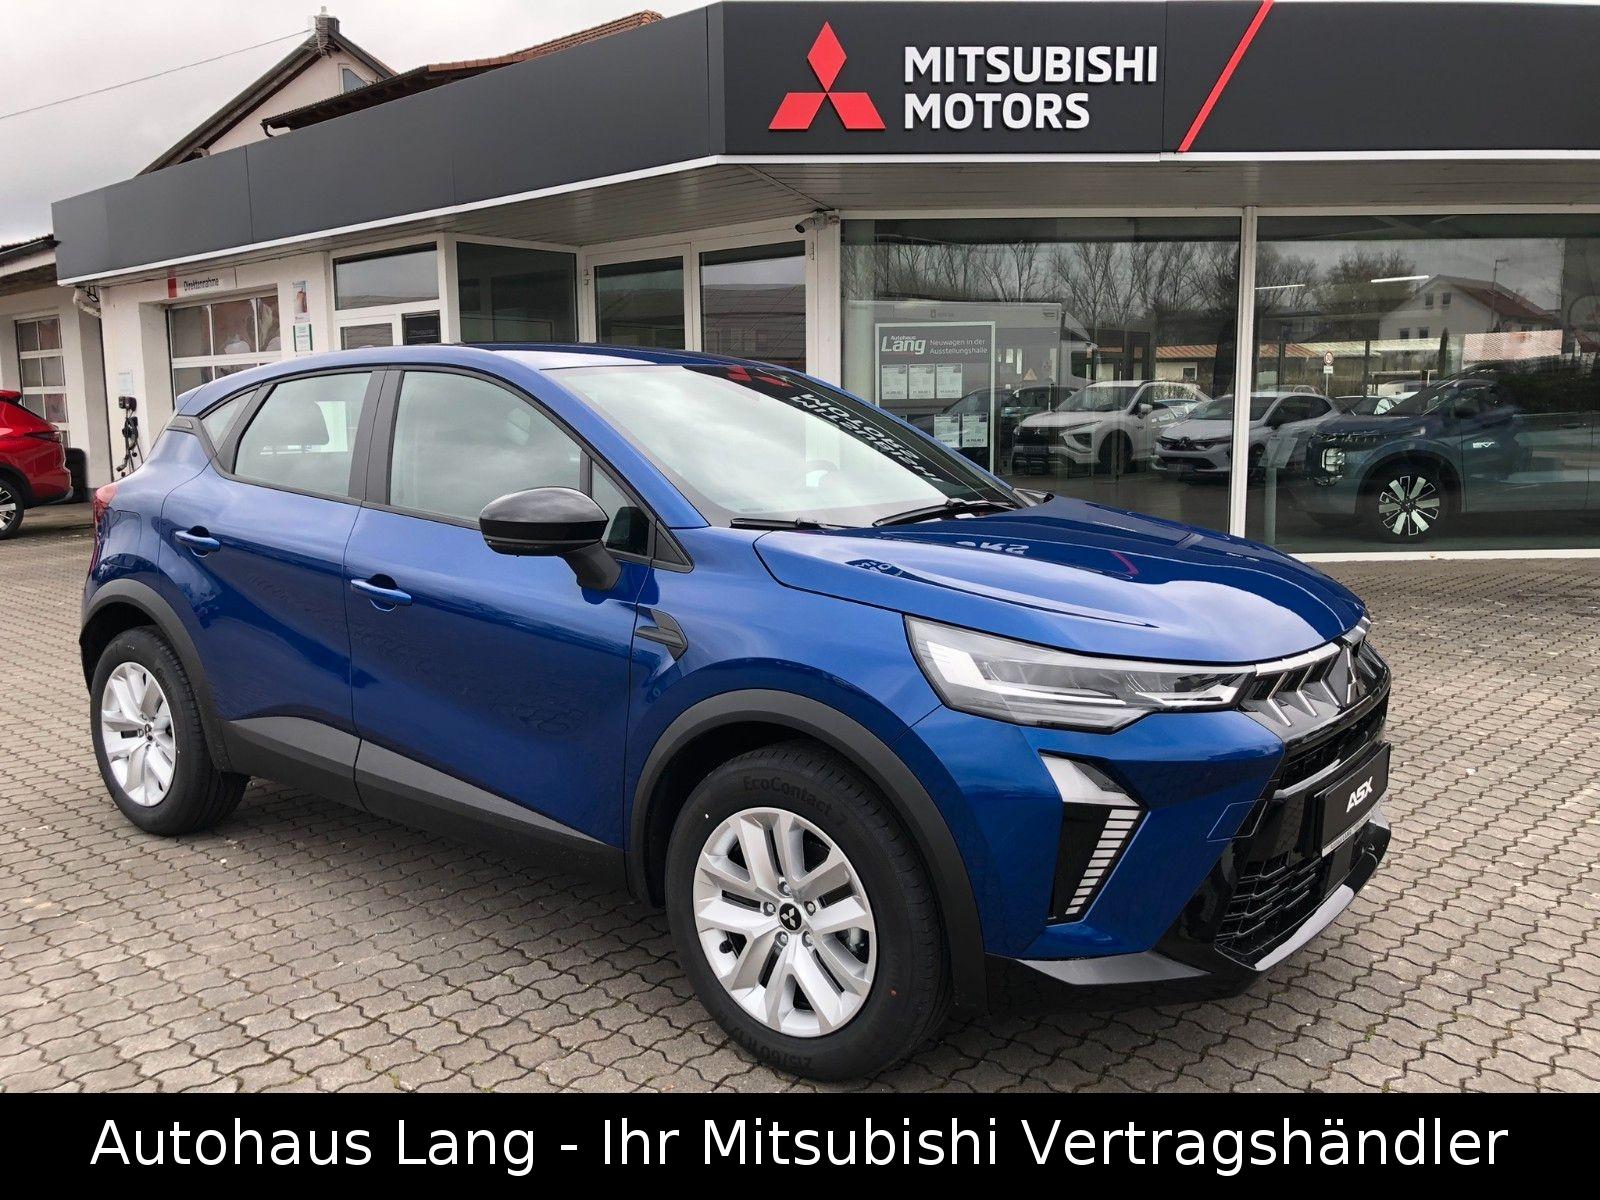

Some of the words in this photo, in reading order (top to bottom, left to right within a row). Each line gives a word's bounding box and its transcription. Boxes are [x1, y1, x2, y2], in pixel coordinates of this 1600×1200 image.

[904, 46, 1158, 83] MITSUBISHI
[904, 92, 1090, 129] MOTORS
[881, 336, 926, 355] Lang
[929, 339, 965, 347] Neuwagen
[929, 346, 988, 355] Ausstellungshalle
[742, 775, 833, 817] EcoContact
[1346, 776, 1373, 812] ASX
